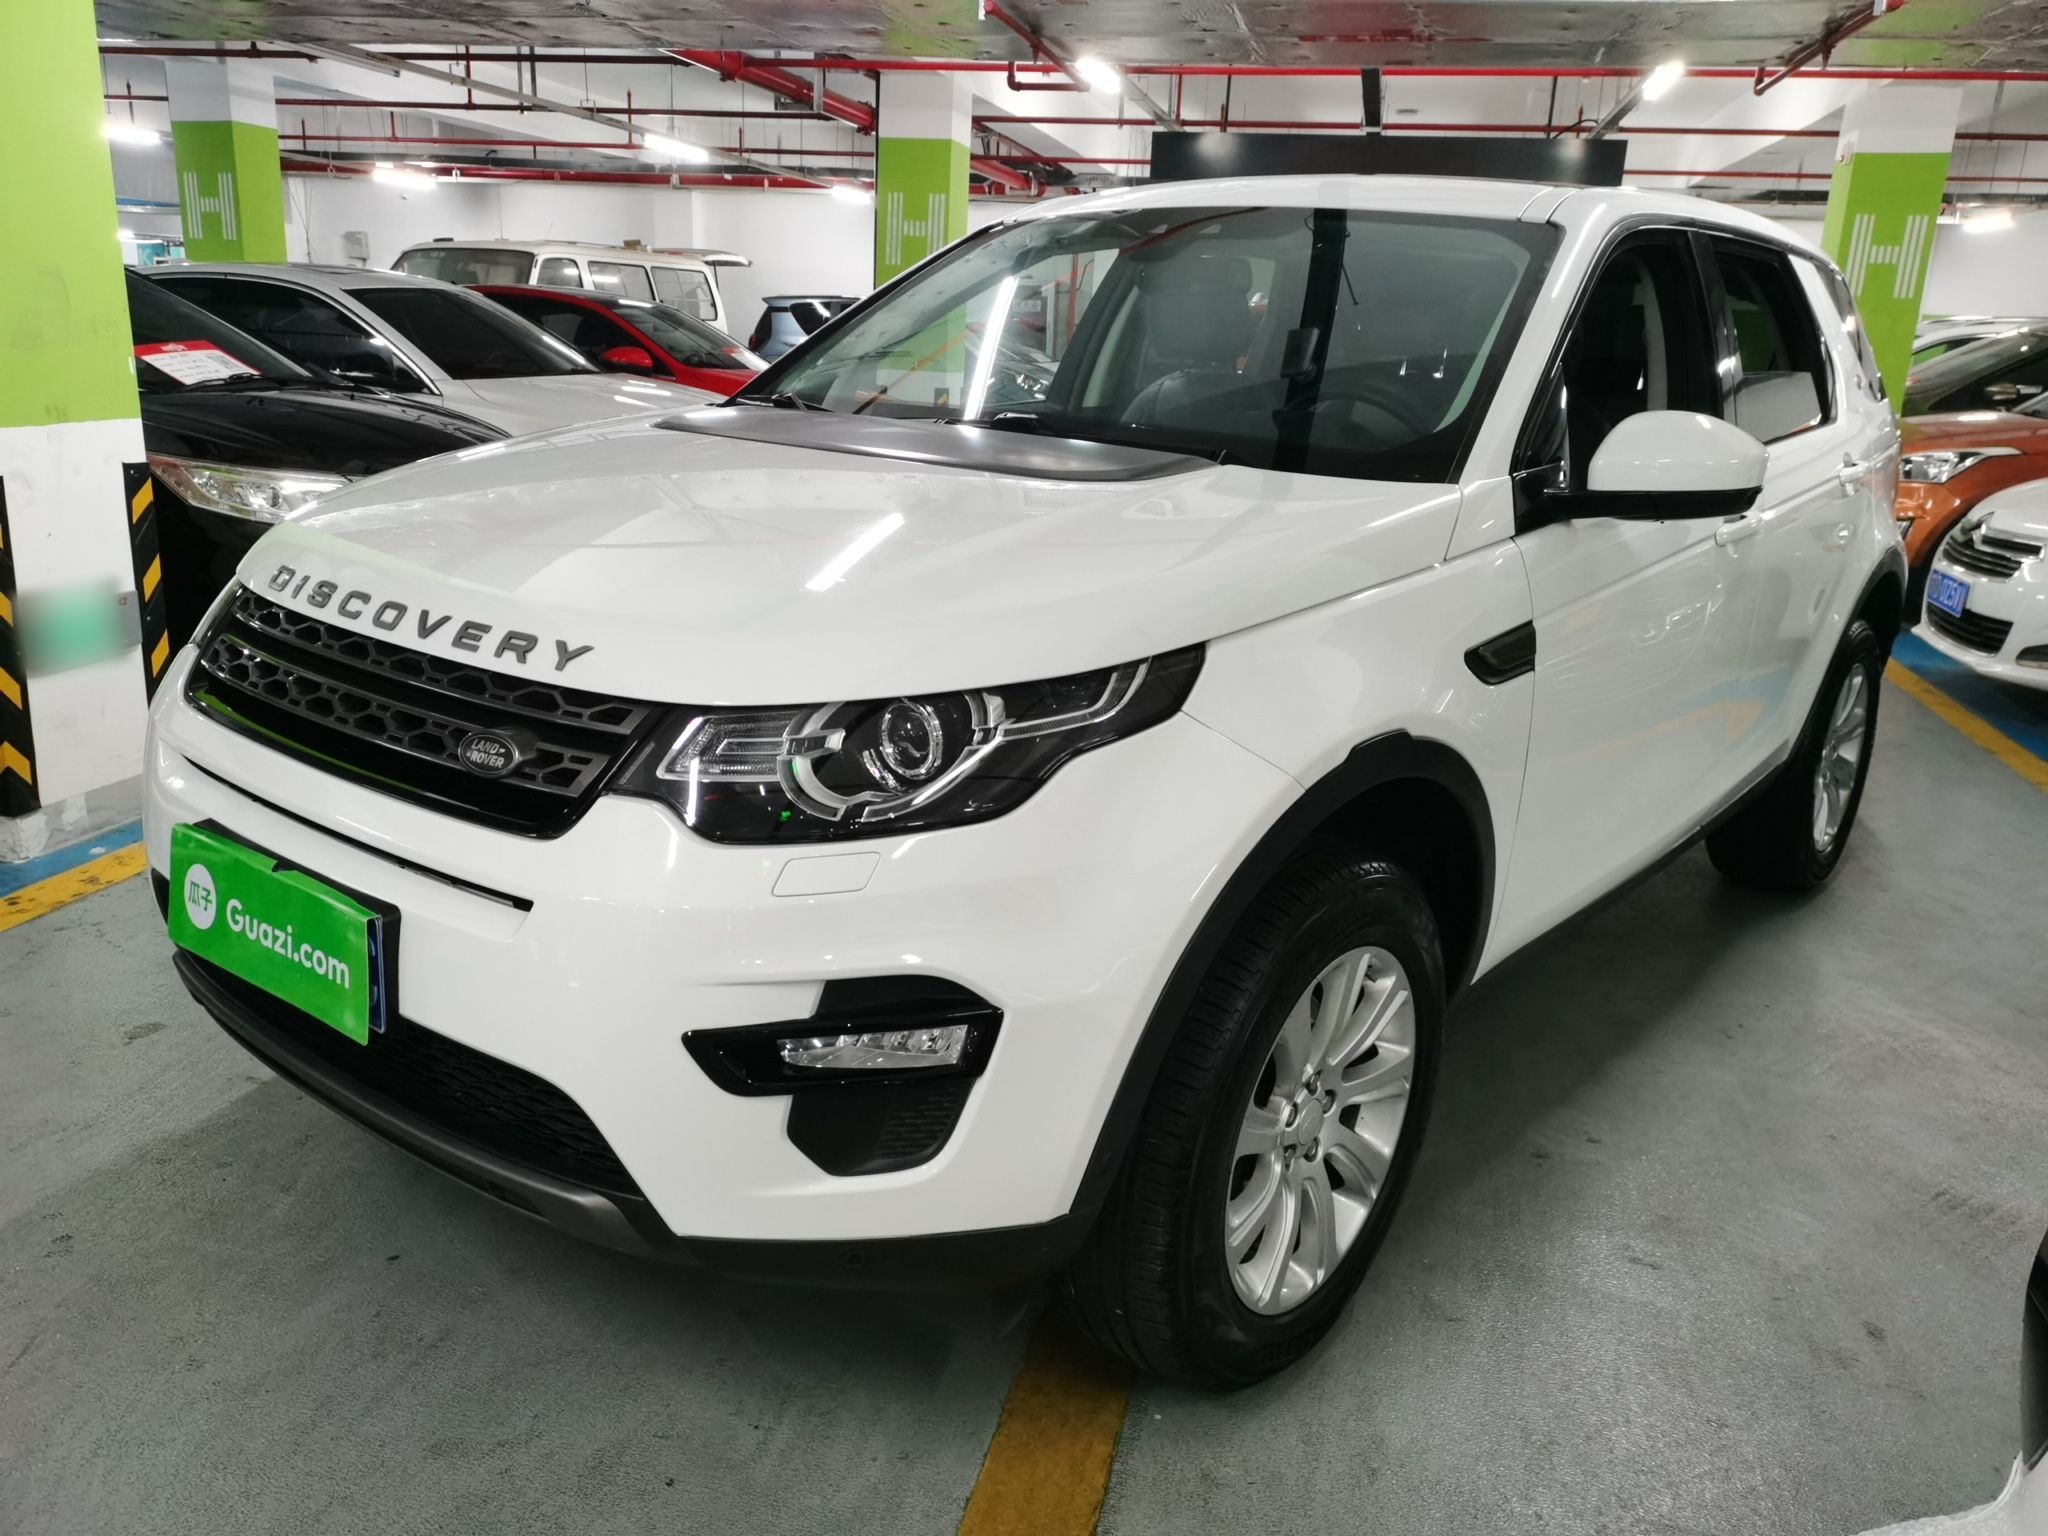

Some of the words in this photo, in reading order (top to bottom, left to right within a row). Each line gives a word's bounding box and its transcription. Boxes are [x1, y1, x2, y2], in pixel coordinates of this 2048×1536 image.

[183, 172, 237, 241] H
[885, 191, 946, 265] H
[1845, 213, 1929, 299] H
[267, 564, 594, 672] DISCOVERY
[188, 880, 213, 912] 瓜子
[226, 898, 350, 990] Guazi.com
